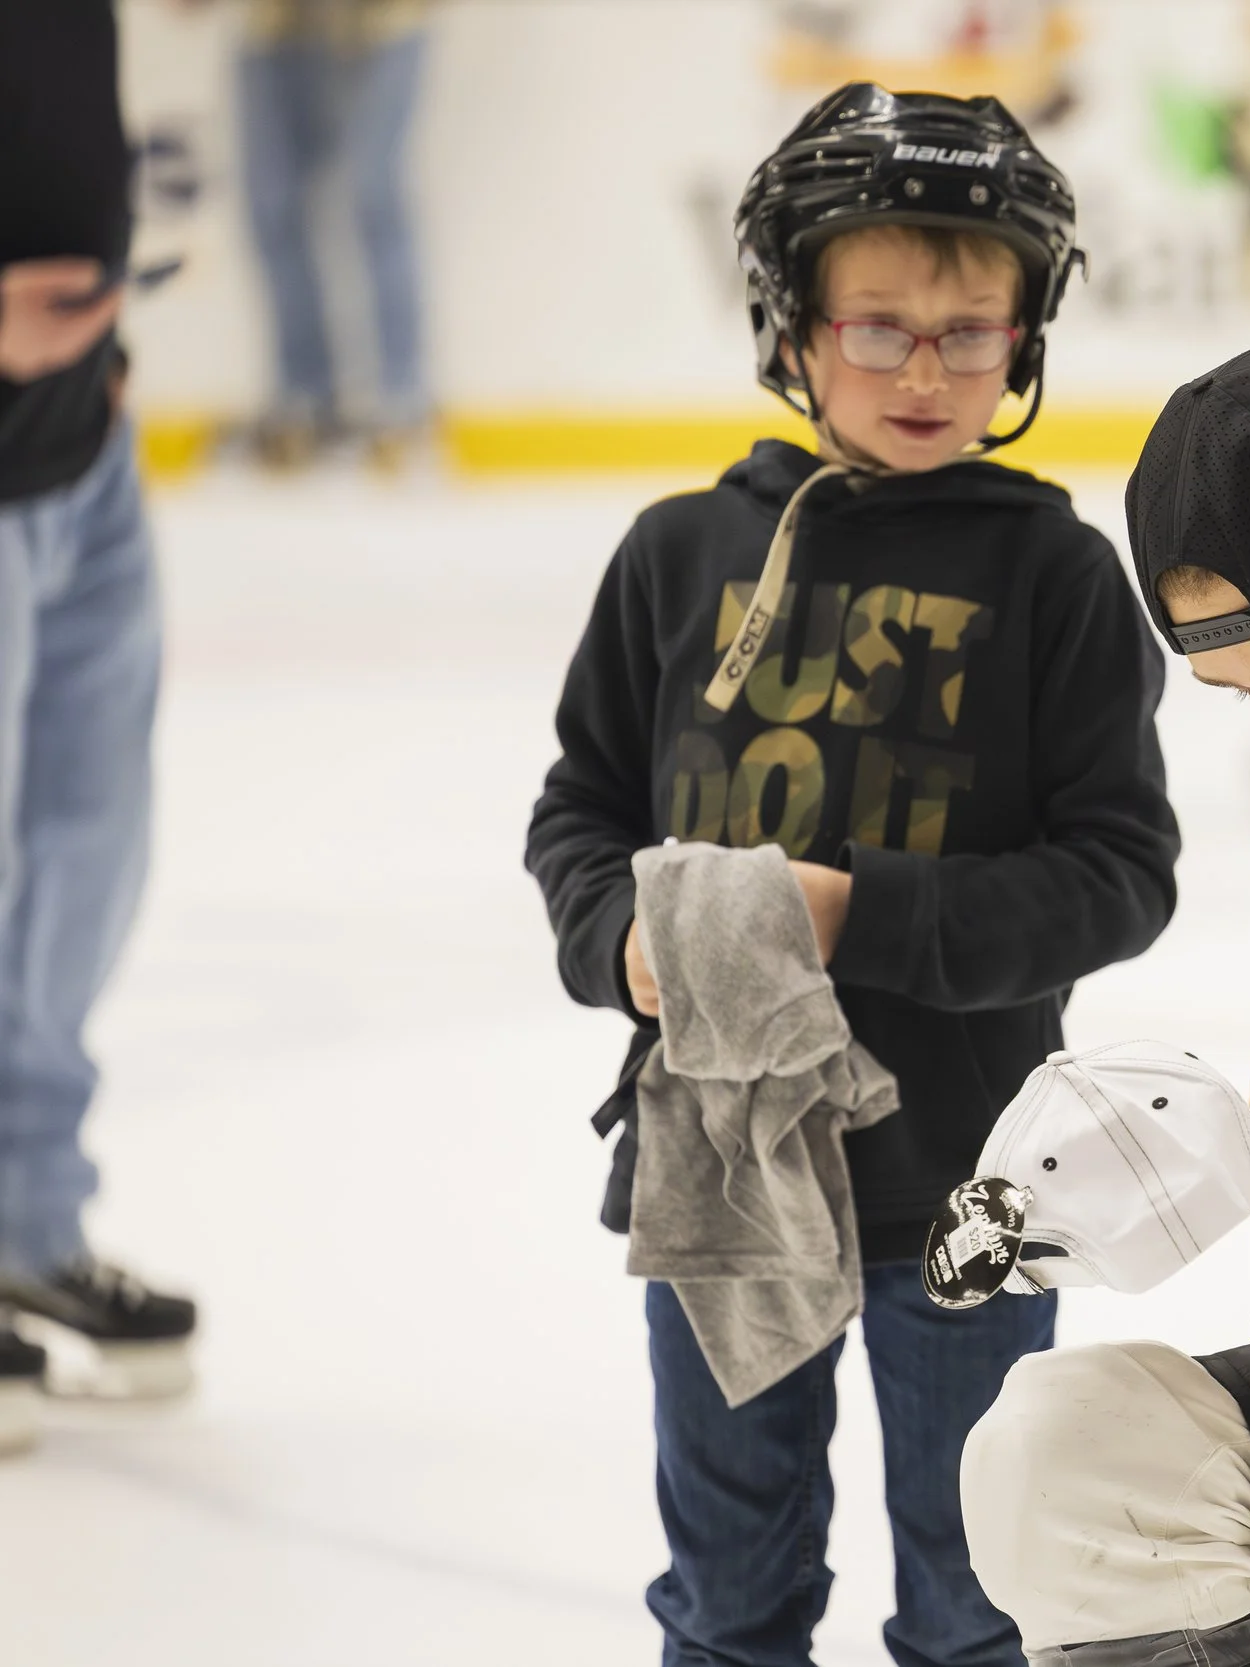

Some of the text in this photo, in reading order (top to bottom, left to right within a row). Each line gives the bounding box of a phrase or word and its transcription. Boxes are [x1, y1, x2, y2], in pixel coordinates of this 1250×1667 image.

[694, 580, 995, 738] JUST
[671, 727, 976, 862] DO IT
[960, 1185, 1010, 1264] Zephyr
[968, 1226, 980, 1251] $20
